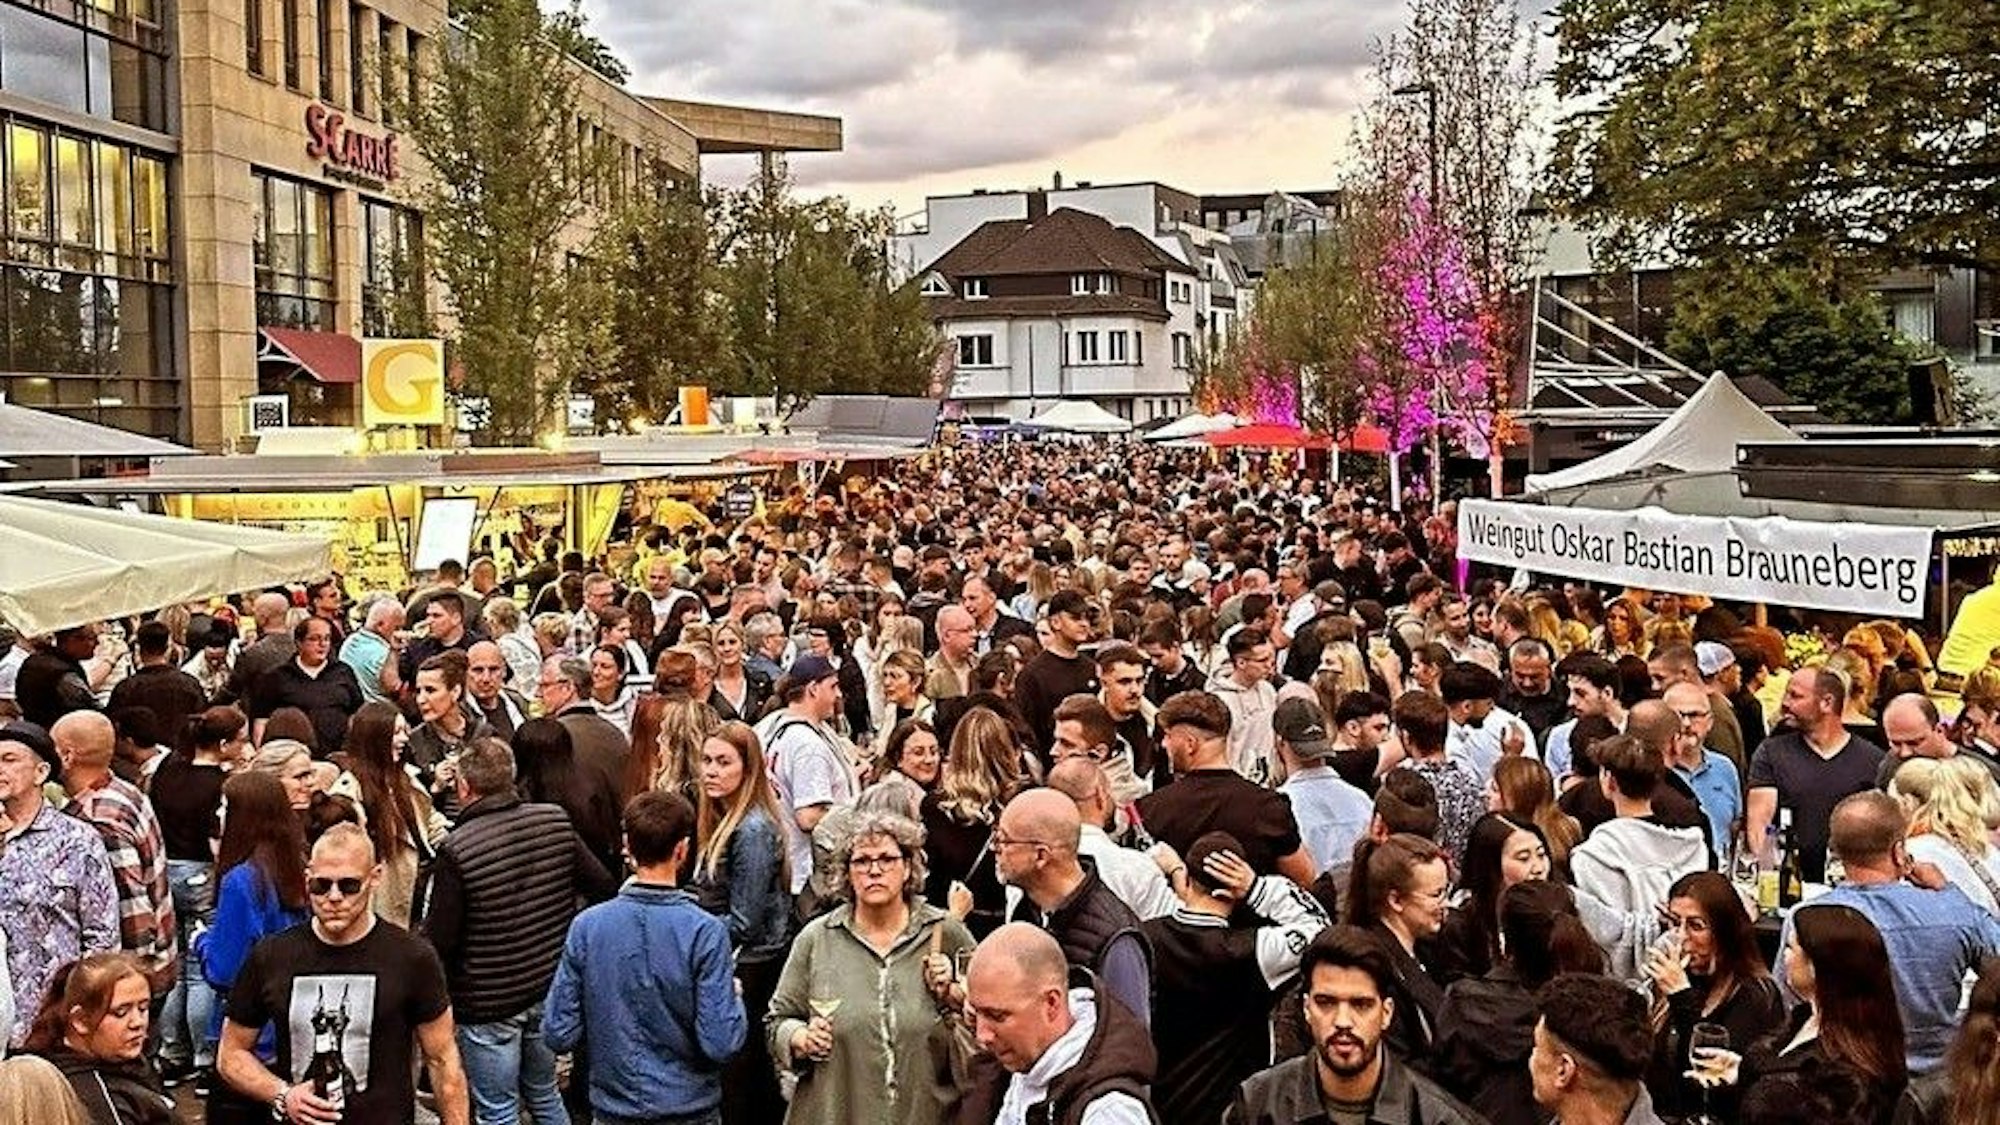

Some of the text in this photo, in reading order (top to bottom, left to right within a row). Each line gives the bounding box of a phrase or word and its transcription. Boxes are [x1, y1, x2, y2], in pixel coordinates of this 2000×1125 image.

[367, 343, 439, 414] G
[1468, 513, 1546, 559] Weingut
[1552, 523, 1614, 563] Oskar
[1624, 531, 1713, 576] Bastian
[1727, 539, 1917, 603] Brauneberg
